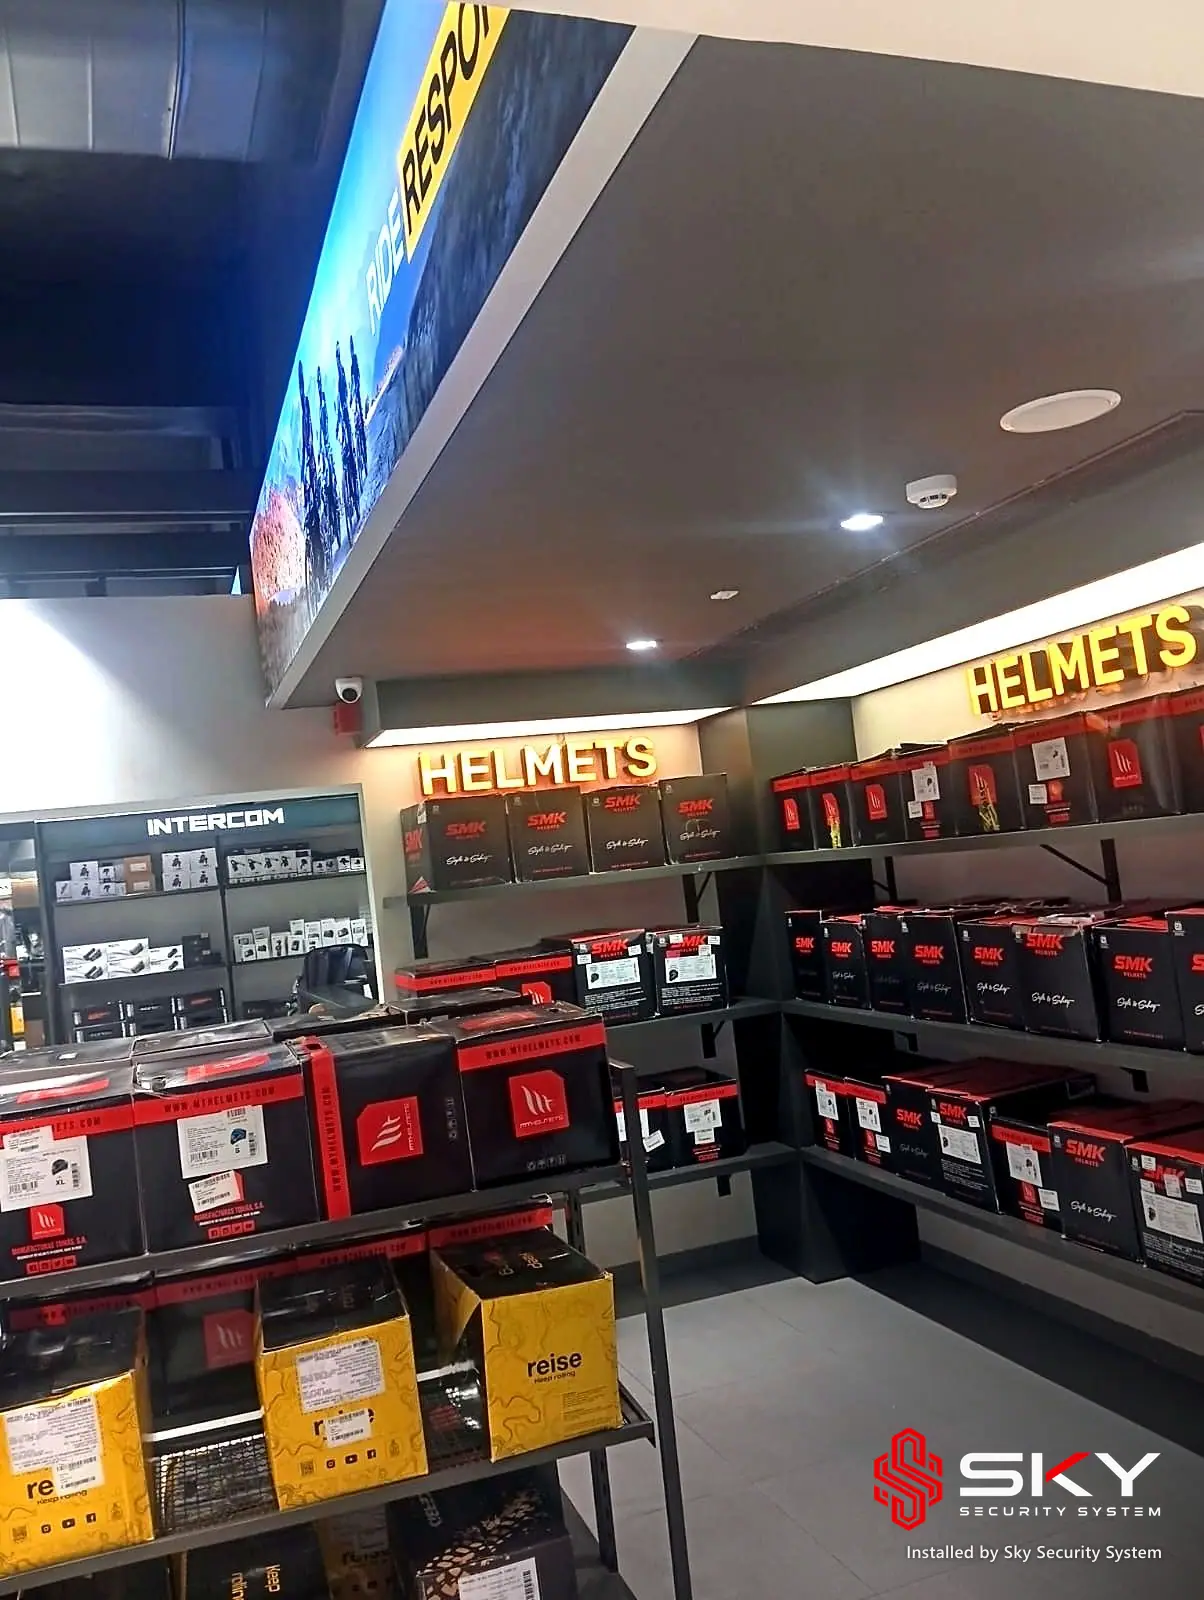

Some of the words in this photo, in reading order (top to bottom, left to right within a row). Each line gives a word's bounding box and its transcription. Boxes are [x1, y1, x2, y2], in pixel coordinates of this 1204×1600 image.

[366, 187, 404, 336] RIDE
[402, 3, 490, 236] RESPO
[967, 605, 1197, 716] HELMETS
[418, 736, 658, 795] HELMETS
[604, 794, 640, 809] SMK
[678, 799, 713, 814] SMK
[147, 807, 285, 836] INTERCOM
[527, 811, 568, 827] SMK
[445, 821, 486, 836] SMK
[592, 938, 630, 954] SMK
[796, 937, 814, 949] SMK
[831, 942, 852, 953] SMK
[871, 940, 895, 953] SMK
[1026, 932, 1064, 950] SMK
[915, 945, 944, 960] SMK
[974, 946, 1004, 961] SMK
[1114, 955, 1153, 972] SMK
[897, 1108, 922, 1126] SMK
[939, 1102, 967, 1120] SMK
[1066, 1138, 1106, 1161] SMK
[527, 1352, 582, 1378] reise
